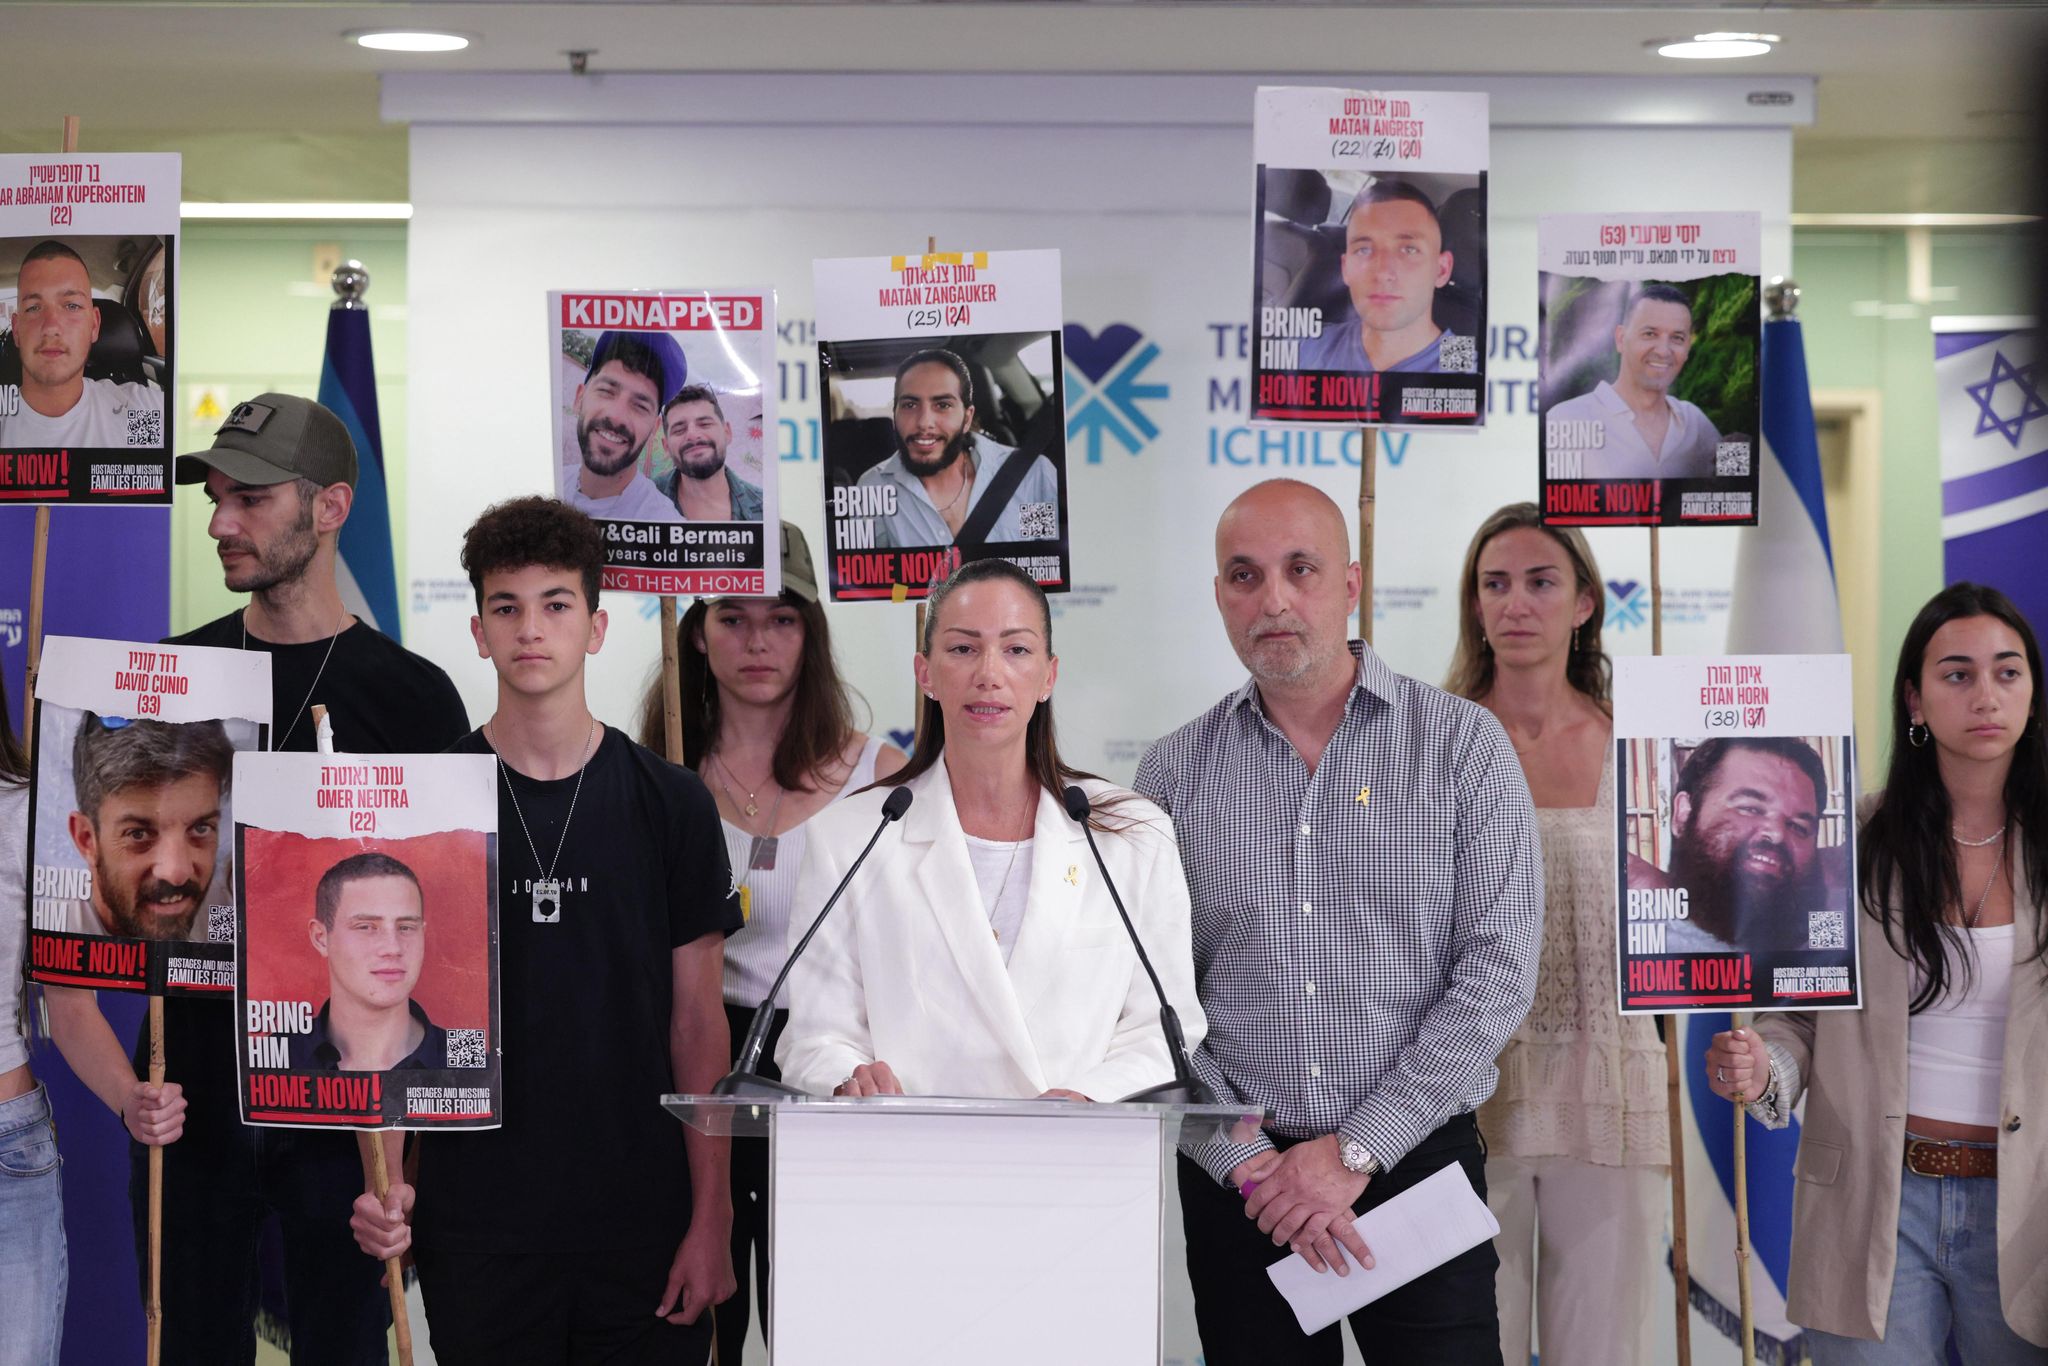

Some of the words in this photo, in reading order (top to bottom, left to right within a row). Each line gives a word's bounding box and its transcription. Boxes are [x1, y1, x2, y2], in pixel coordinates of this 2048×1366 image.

[1329, 118, 1370, 136] MATAN
[1373, 119, 1424, 137] ANGREST
[29, 164, 83, 185] קופרשטיין
[86, 164, 101, 182] בר
[0, 188, 13, 205] AR
[15, 186, 63, 205] ABRAHAM
[66, 185, 145, 203] KUPERSHTEIN
[50, 205, 72, 226] (22)
[1600, 224, 1626, 246] (53)
[1630, 225, 1672, 244] שרעבי
[1675, 224, 1700, 244] יוסי
[1697, 248, 1710, 264] על
[1712, 248, 1736, 264] נרצח
[952, 264, 976, 285] מתן
[879, 287, 922, 307] MATAN
[924, 284, 996, 305] ZANGAUKER
[569, 299, 754, 327] KIDNAPPED
[907, 309, 942, 329] (25)
[1260, 307, 1323, 338] BRING
[1260, 339, 1299, 370] HIM
[1259, 374, 1317, 407] HOME
[1322, 373, 1381, 407] NOW!
[1402, 398, 1442, 413] FAMILIES
[1443, 398, 1476, 413] FORUM
[1546, 420, 1605, 449] BRING
[17, 450, 69, 485] NOW!
[91, 464, 122, 475] HOSTAGES
[123, 464, 136, 475] AND
[136, 464, 163, 475] MISSING
[1546, 451, 1583, 479] HIM
[90, 475, 130, 490] FAMILIES
[132, 475, 163, 490] FORUM
[833, 484, 898, 517] BRING
[1546, 484, 1600, 513] HOME
[1605, 479, 1661, 513] NOW!
[1681, 502, 1720, 515] FAMILIES
[1721, 501, 1752, 515] FORUM
[669, 526, 754, 545] Berman
[835, 519, 875, 550] HIM
[607, 549, 647, 562] years
[653, 548, 678, 563] old
[684, 549, 745, 563] Israelis
[1016, 556, 1030, 567] AND
[1031, 556, 1060, 567] MISSING
[836, 553, 896, 585] HOME
[634, 574, 691, 592] THEM
[700, 575, 763, 592] HOME
[129, 651, 156, 673] קוניו
[159, 653, 178, 673] דוד
[115, 671, 150, 692] DAVID
[152, 675, 188, 695] CUNIO
[1707, 666, 1731, 686] הורן
[1735, 666, 1762, 686] איתן
[137, 694, 160, 715] (33)
[1700, 687, 1734, 705] EITAN
[1737, 686, 1769, 705] HORN
[1704, 709, 1740, 730] (38)
[321, 766, 368, 785] נאוטרה
[372, 766, 404, 785] עומר
[317, 788, 353, 808] OMER
[357, 788, 408, 808] NEUTRA
[349, 810, 376, 833] (22)
[33, 864, 92, 901] BRING
[1627, 887, 1689, 920] BRING
[32, 900, 68, 932] HIM
[1627, 923, 1666, 954] HIM
[32, 934, 83, 971] HOME
[89, 942, 146, 977] NOW!
[168, 957, 202, 969] HOSTAGES
[202, 960, 216, 970] AND
[217, 961, 235, 971] MISS
[167, 968, 210, 985] FAMILIES
[1628, 959, 1685, 992] HOME
[1691, 954, 1752, 991] NOW!
[1773, 967, 1805, 978] HOSTAGES
[1805, 967, 1819, 978] AND
[1819, 966, 1848, 977] MISSING
[1773, 978, 1815, 994] FAMILIES
[1816, 977, 1849, 993] FORUM
[247, 1000, 313, 1034] BRING
[248, 1036, 290, 1069] HIM
[250, 1074, 312, 1109] HOME
[317, 1073, 382, 1111] NOW!
[406, 1087, 442, 1099] HOSTAGES
[443, 1087, 457, 1099] AND
[458, 1087, 490, 1098] MISSING
[406, 1099, 452, 1114] FAMILIES
[454, 1099, 490, 1114] FORUM
